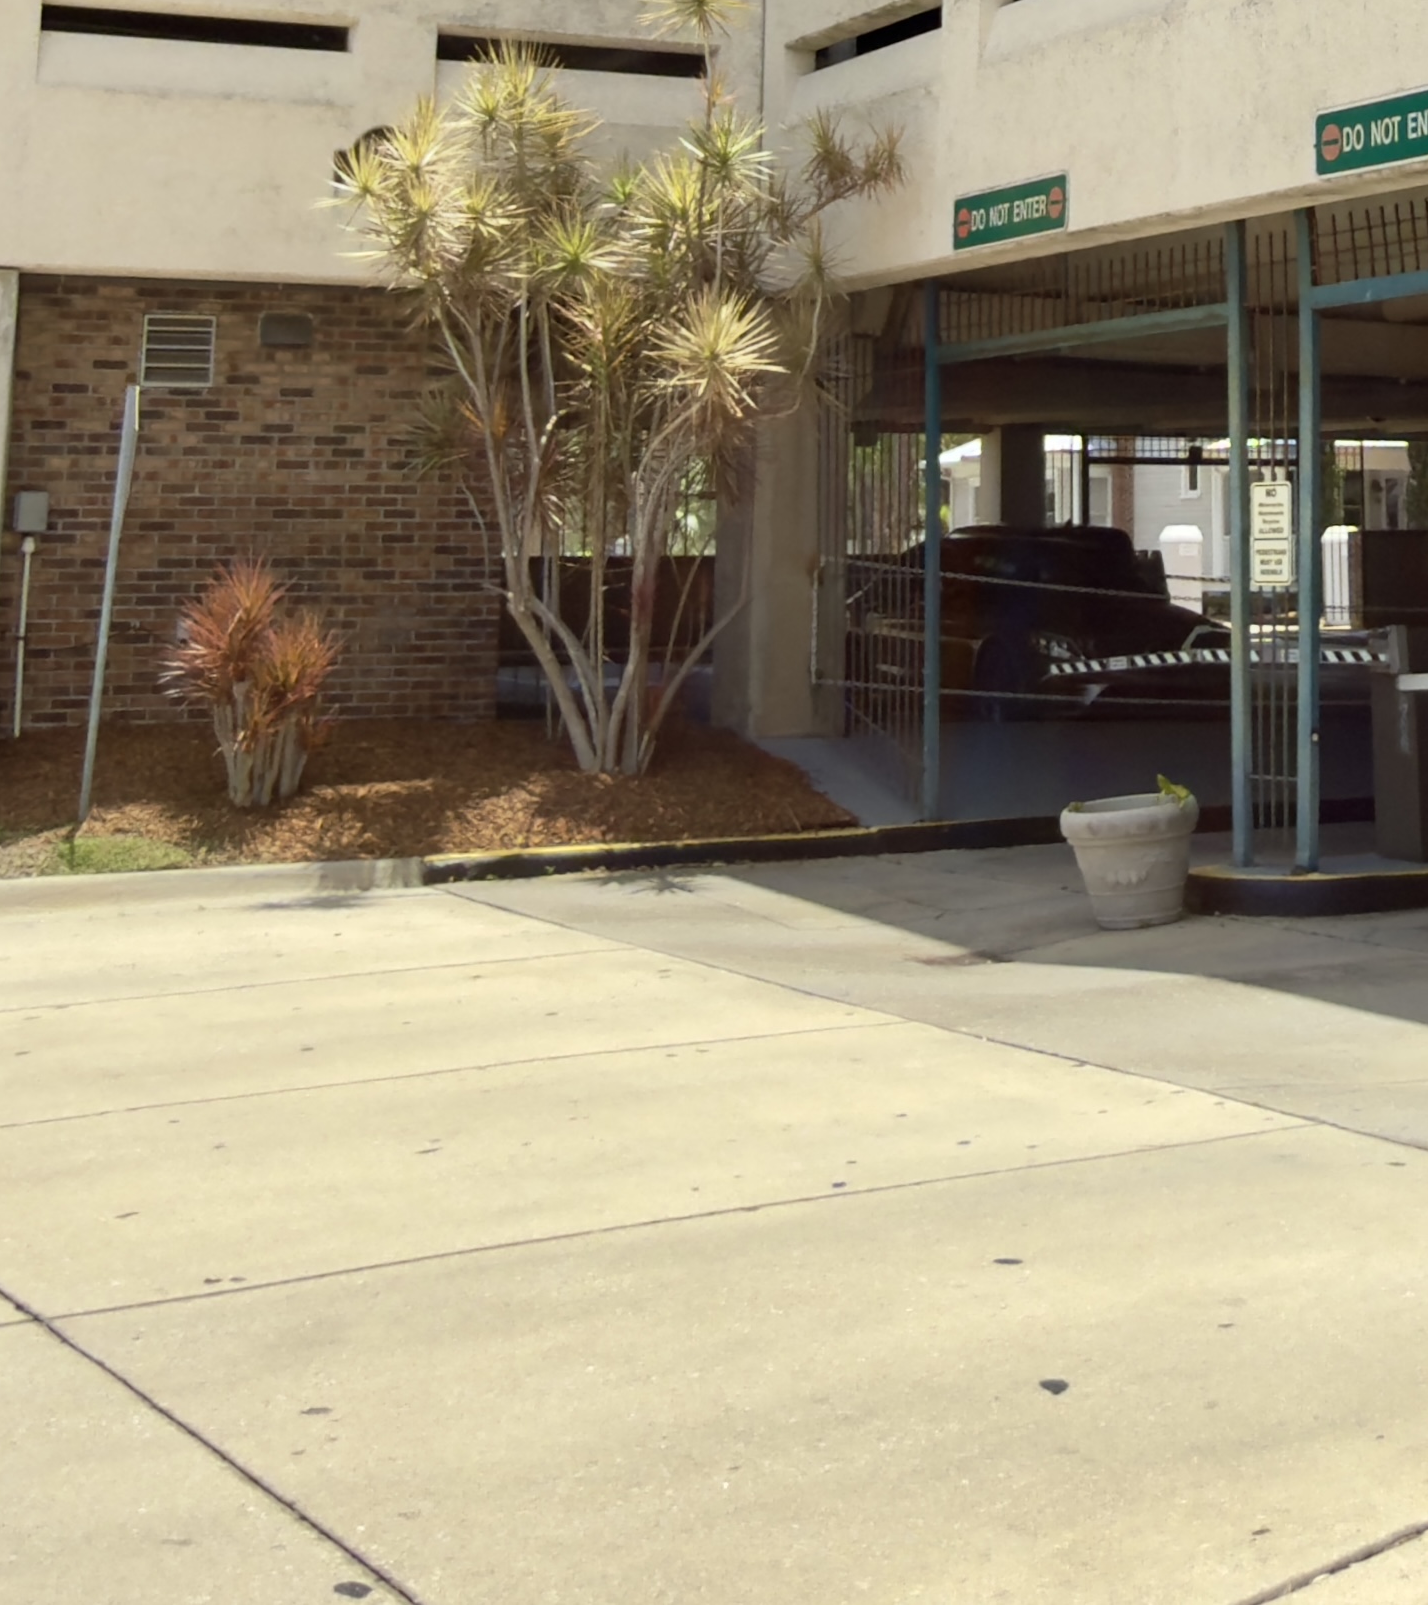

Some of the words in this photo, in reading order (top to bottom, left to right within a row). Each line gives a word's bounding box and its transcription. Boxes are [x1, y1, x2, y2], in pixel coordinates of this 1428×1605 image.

[1342, 124, 1365, 152] DO
[1370, 116, 1402, 147] NOT
[971, 208, 986, 231] DO
[989, 203, 1010, 227] NOT
[1013, 194, 1047, 223] ENTER
[1265, 488, 1277, 498] NO
